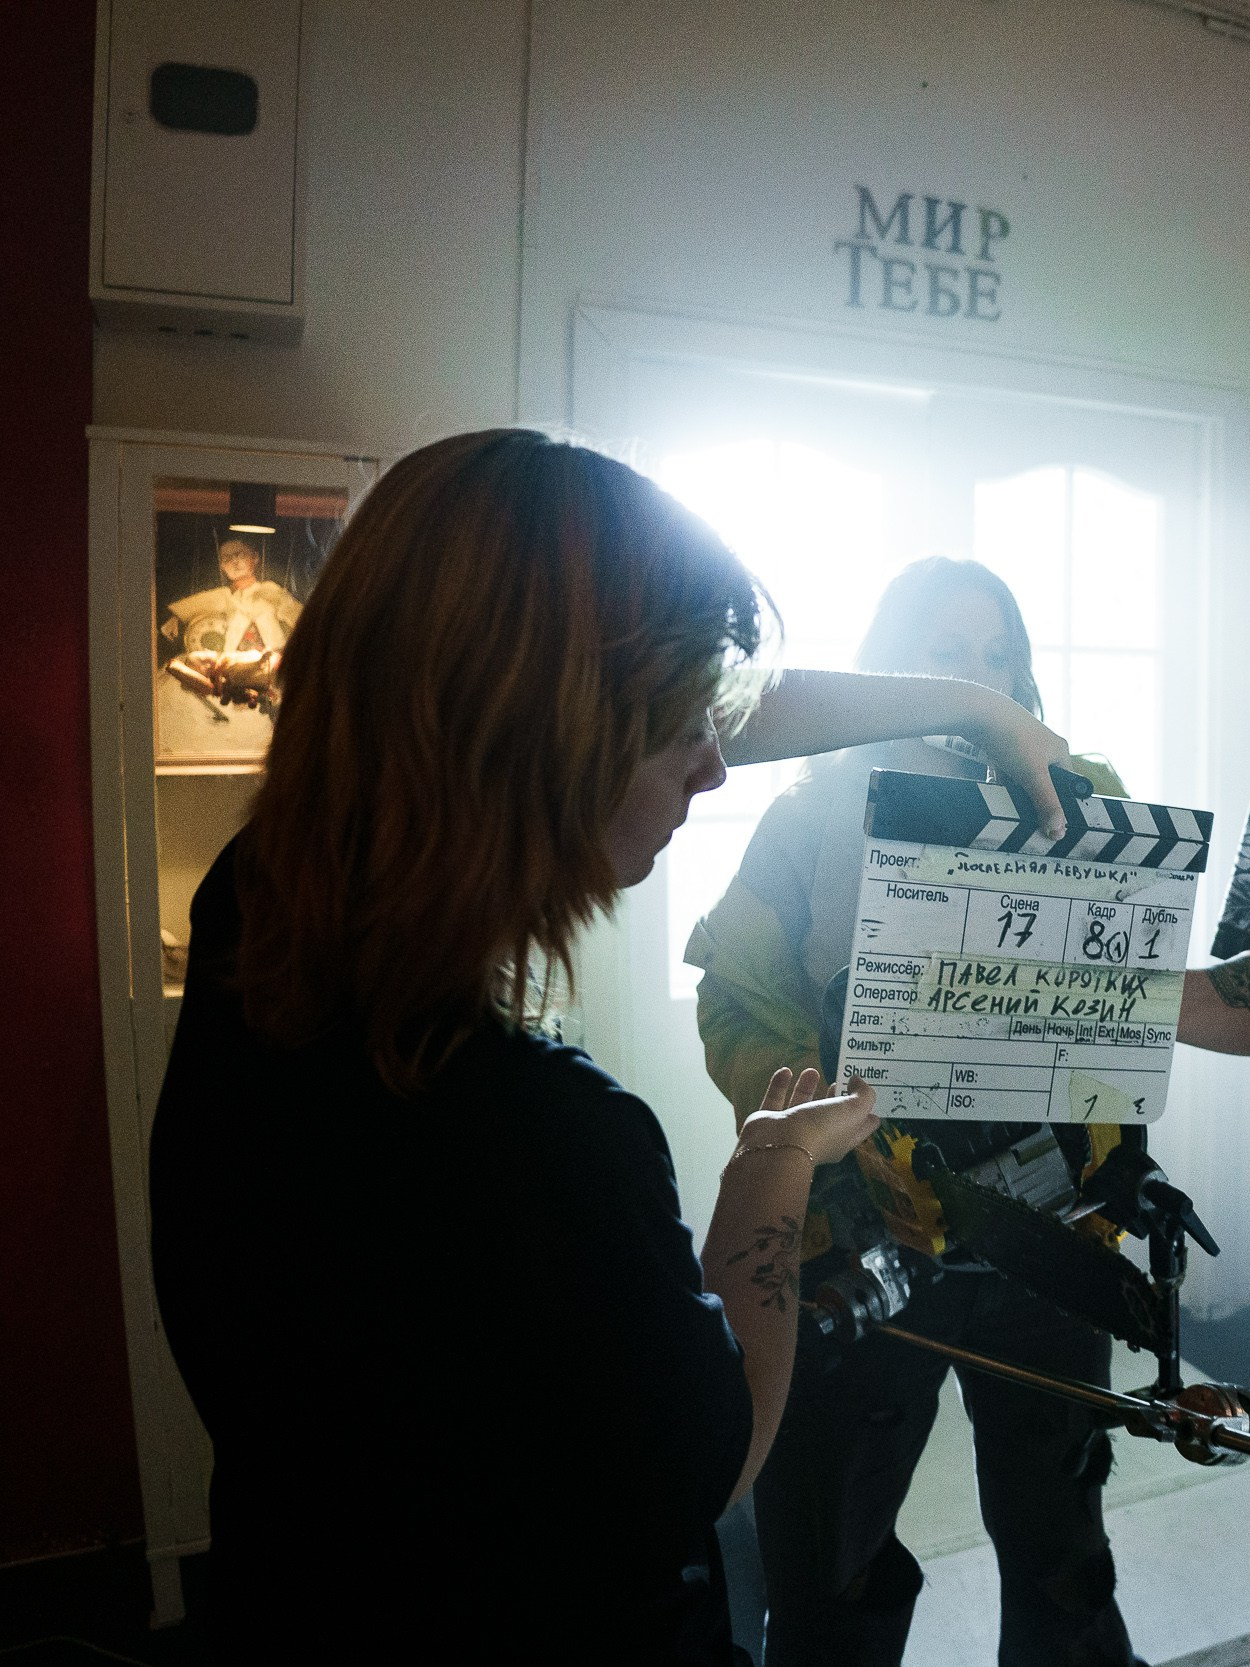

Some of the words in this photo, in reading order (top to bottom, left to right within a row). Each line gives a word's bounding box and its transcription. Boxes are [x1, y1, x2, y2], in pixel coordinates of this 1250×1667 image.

[854, 184, 1011, 262] МИР
[834, 240, 1002, 322] ТЕБЕ
[870, 849, 921, 869] Проект:
[886, 883, 949, 903] Носитель
[1000, 894, 1040, 912] Сцена
[1087, 902, 1116, 921] Кадр
[1142, 908, 1178, 925] Дубль
[997, 910, 1037, 948] 17
[1138, 929, 1160, 960] 1
[856, 957, 925, 978] Режиссёр:
[849, 1011, 883, 1026] Дата:
[1012, 1020, 1042, 1036] День
[1047, 1024, 1074, 1037] Ночь
[1078, 1026, 1094, 1038] Int
[1098, 1026, 1116, 1038] Ext
[1119, 1027, 1141, 1040] Mos
[1146, 1029, 1172, 1044] Sync
[847, 1037, 895, 1054] Фильтр:
[1057, 1049, 1069, 1062] F:
[843, 1064, 889, 1080] Shutter:
[955, 1069, 978, 1083] WB:
[950, 1094, 975, 1108] ISO:
